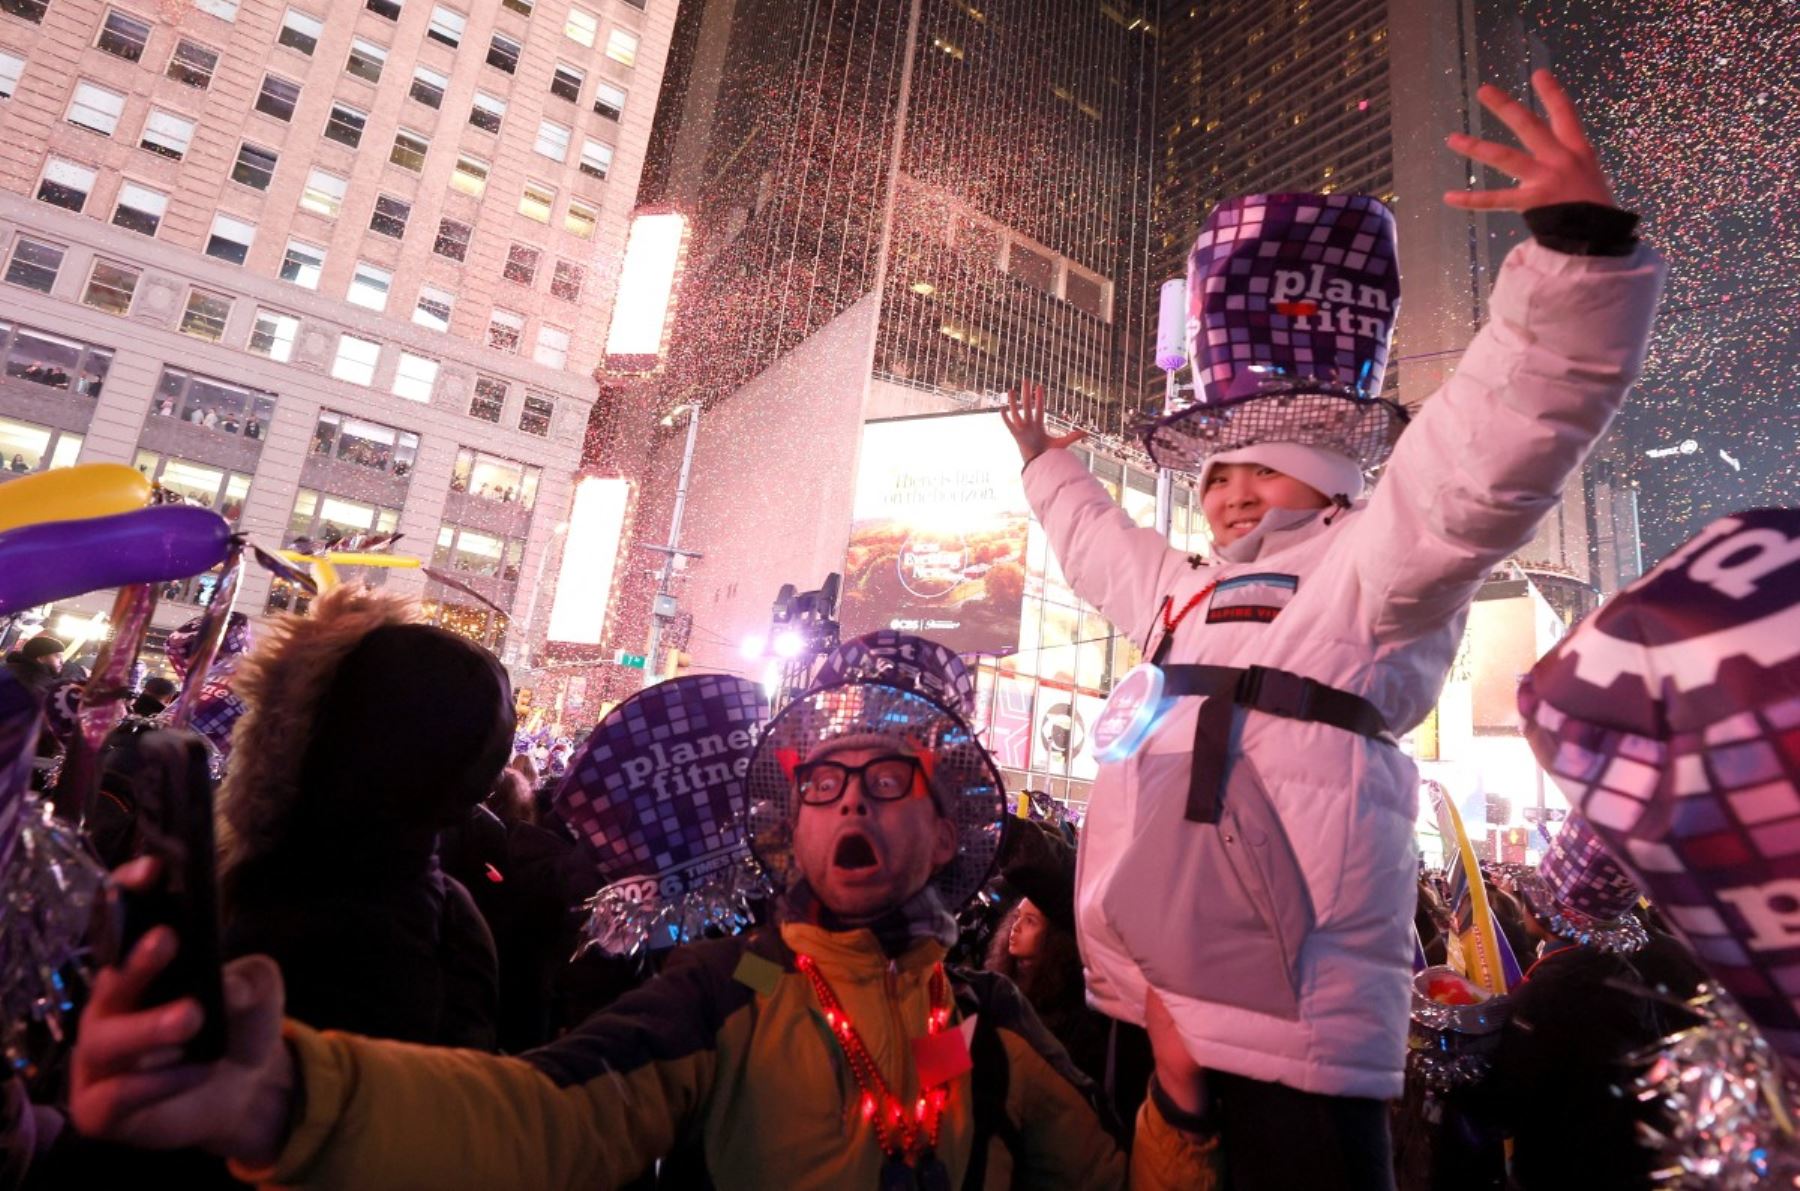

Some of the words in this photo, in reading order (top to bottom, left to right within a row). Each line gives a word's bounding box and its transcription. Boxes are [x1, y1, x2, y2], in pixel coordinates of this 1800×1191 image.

[1270, 263, 1391, 312] plan
[894, 469, 934, 489] There
[955, 468, 992, 487] light
[620, 722, 760, 790] planet
[652, 756, 751, 802] fitne
